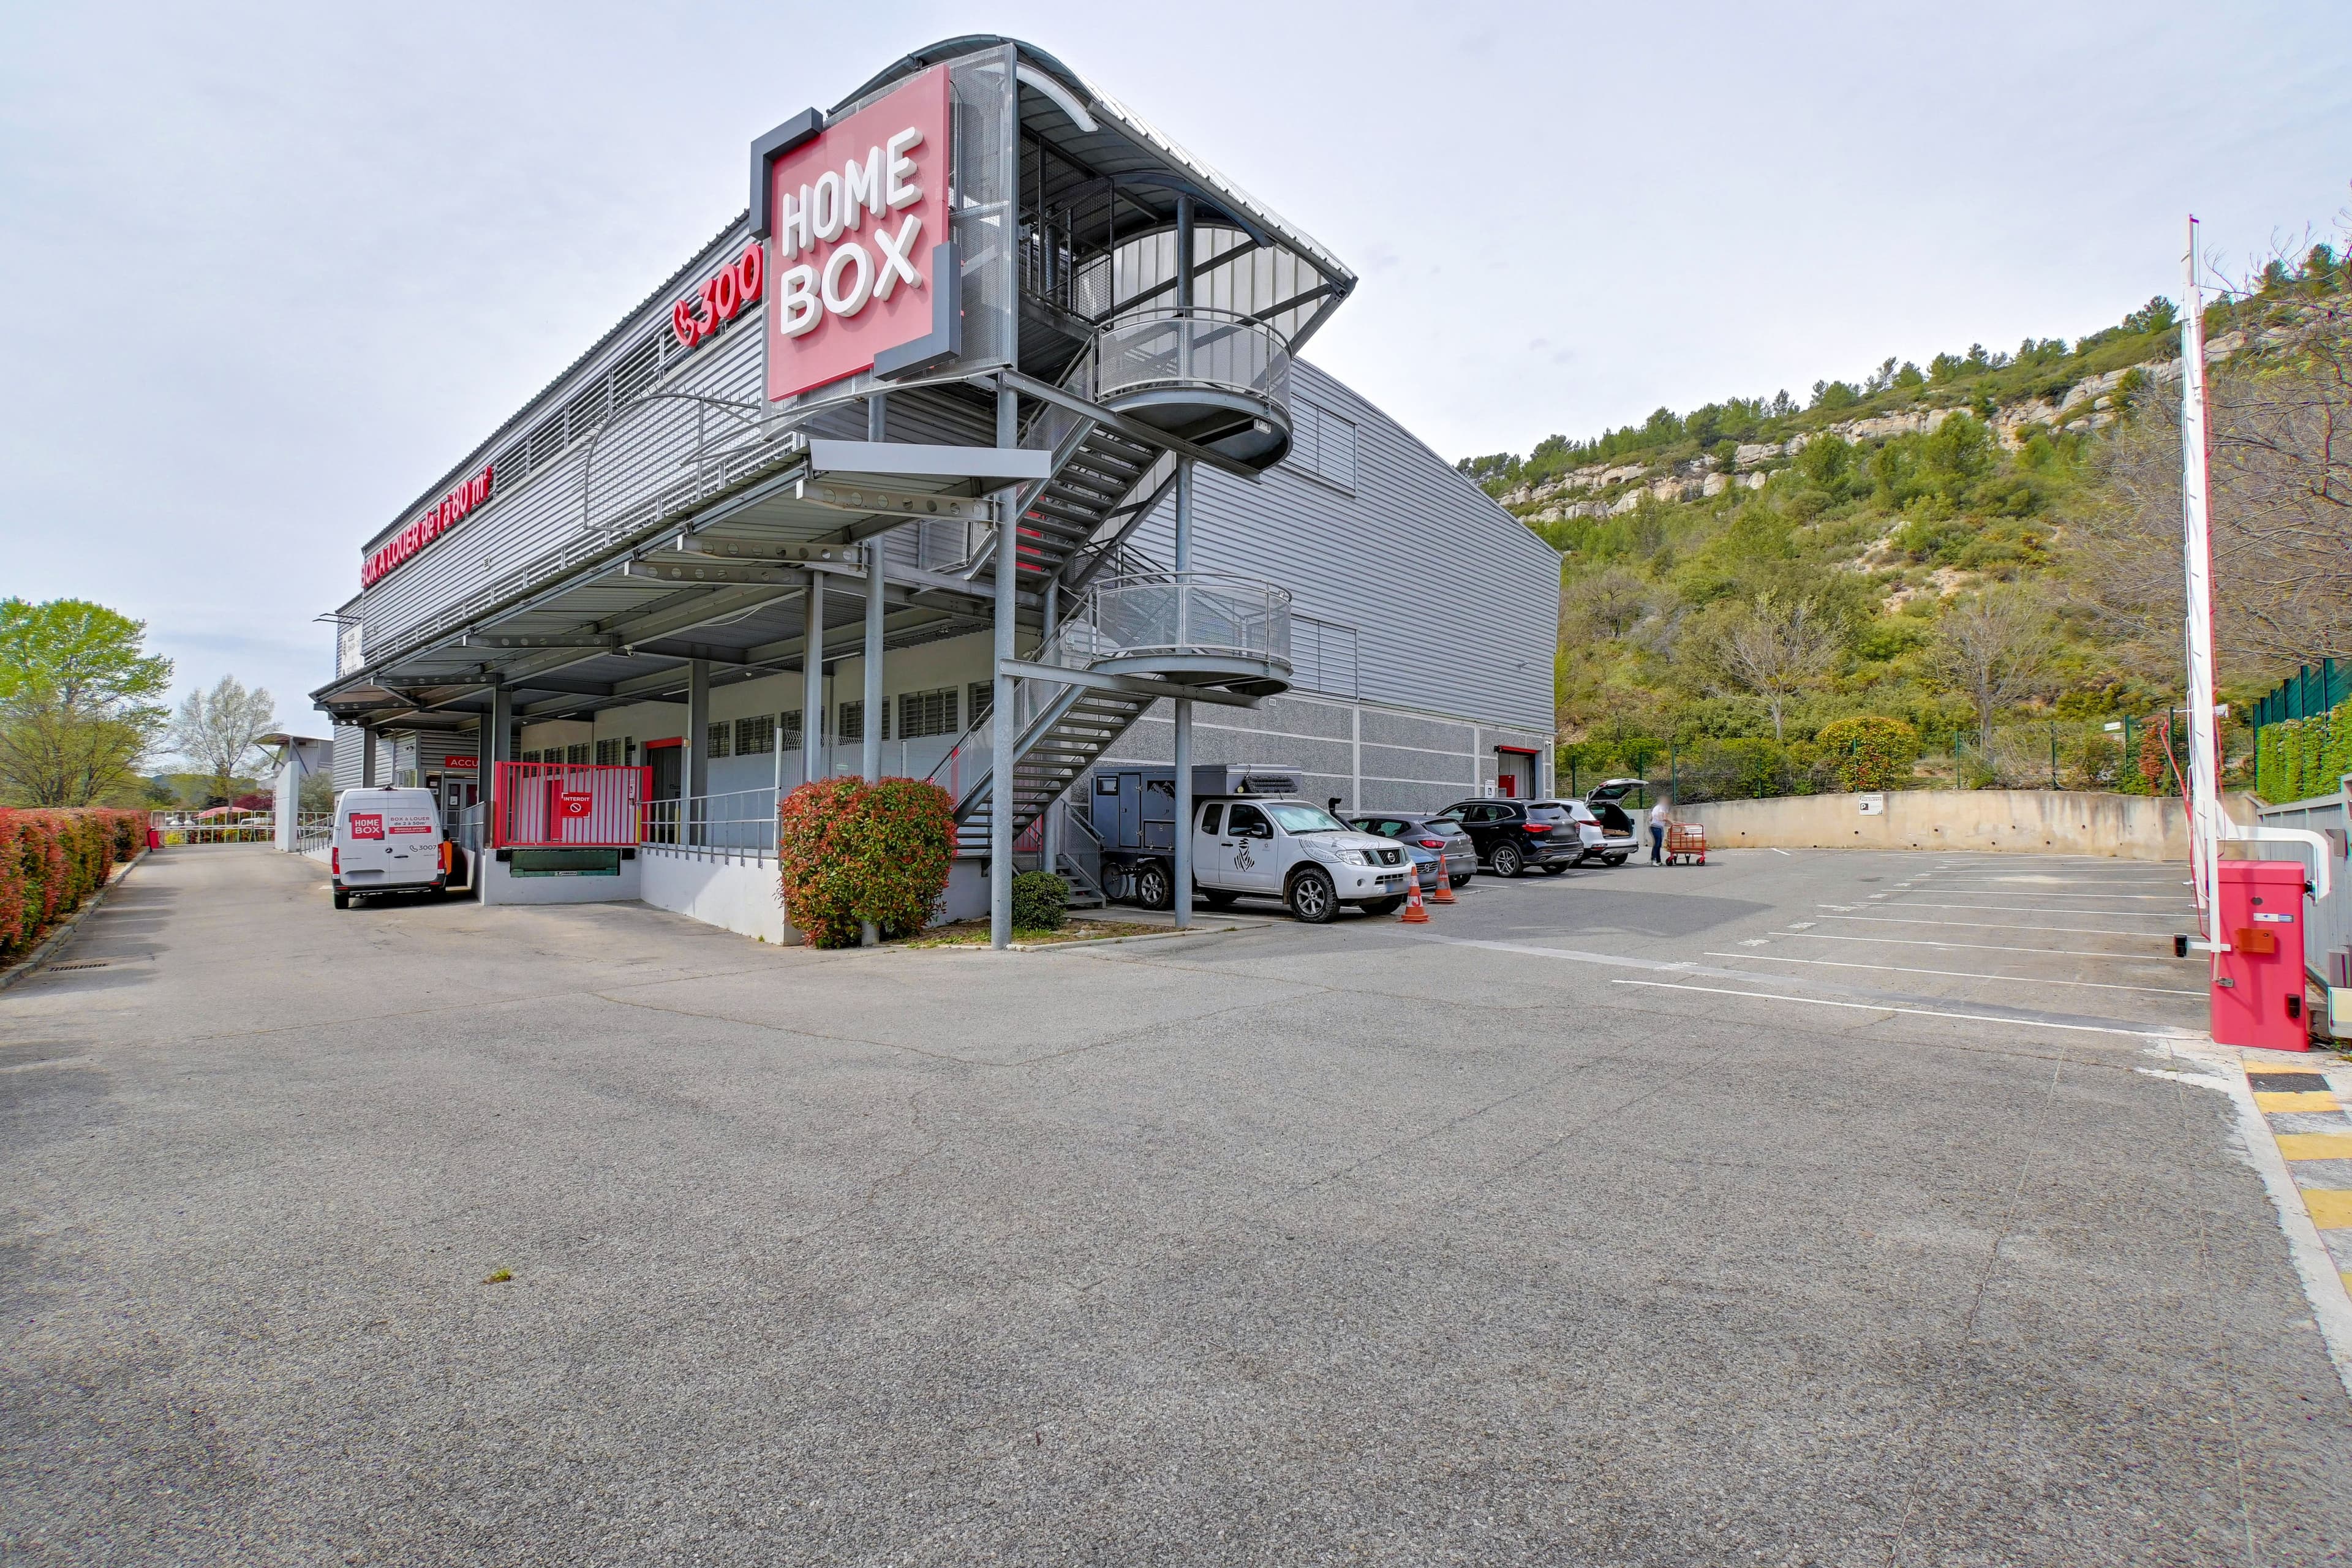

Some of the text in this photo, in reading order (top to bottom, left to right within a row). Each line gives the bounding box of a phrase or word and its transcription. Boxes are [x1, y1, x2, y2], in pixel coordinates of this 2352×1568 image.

[782, 126, 923, 262] HOME
[780, 213, 922, 338] BOX
[361, 554, 379, 588] BOX
[388, 521, 420, 568] LOUER
[421, 510, 436, 542] de
[452, 481, 470, 519] 80
[472, 466, 490, 505] m²
